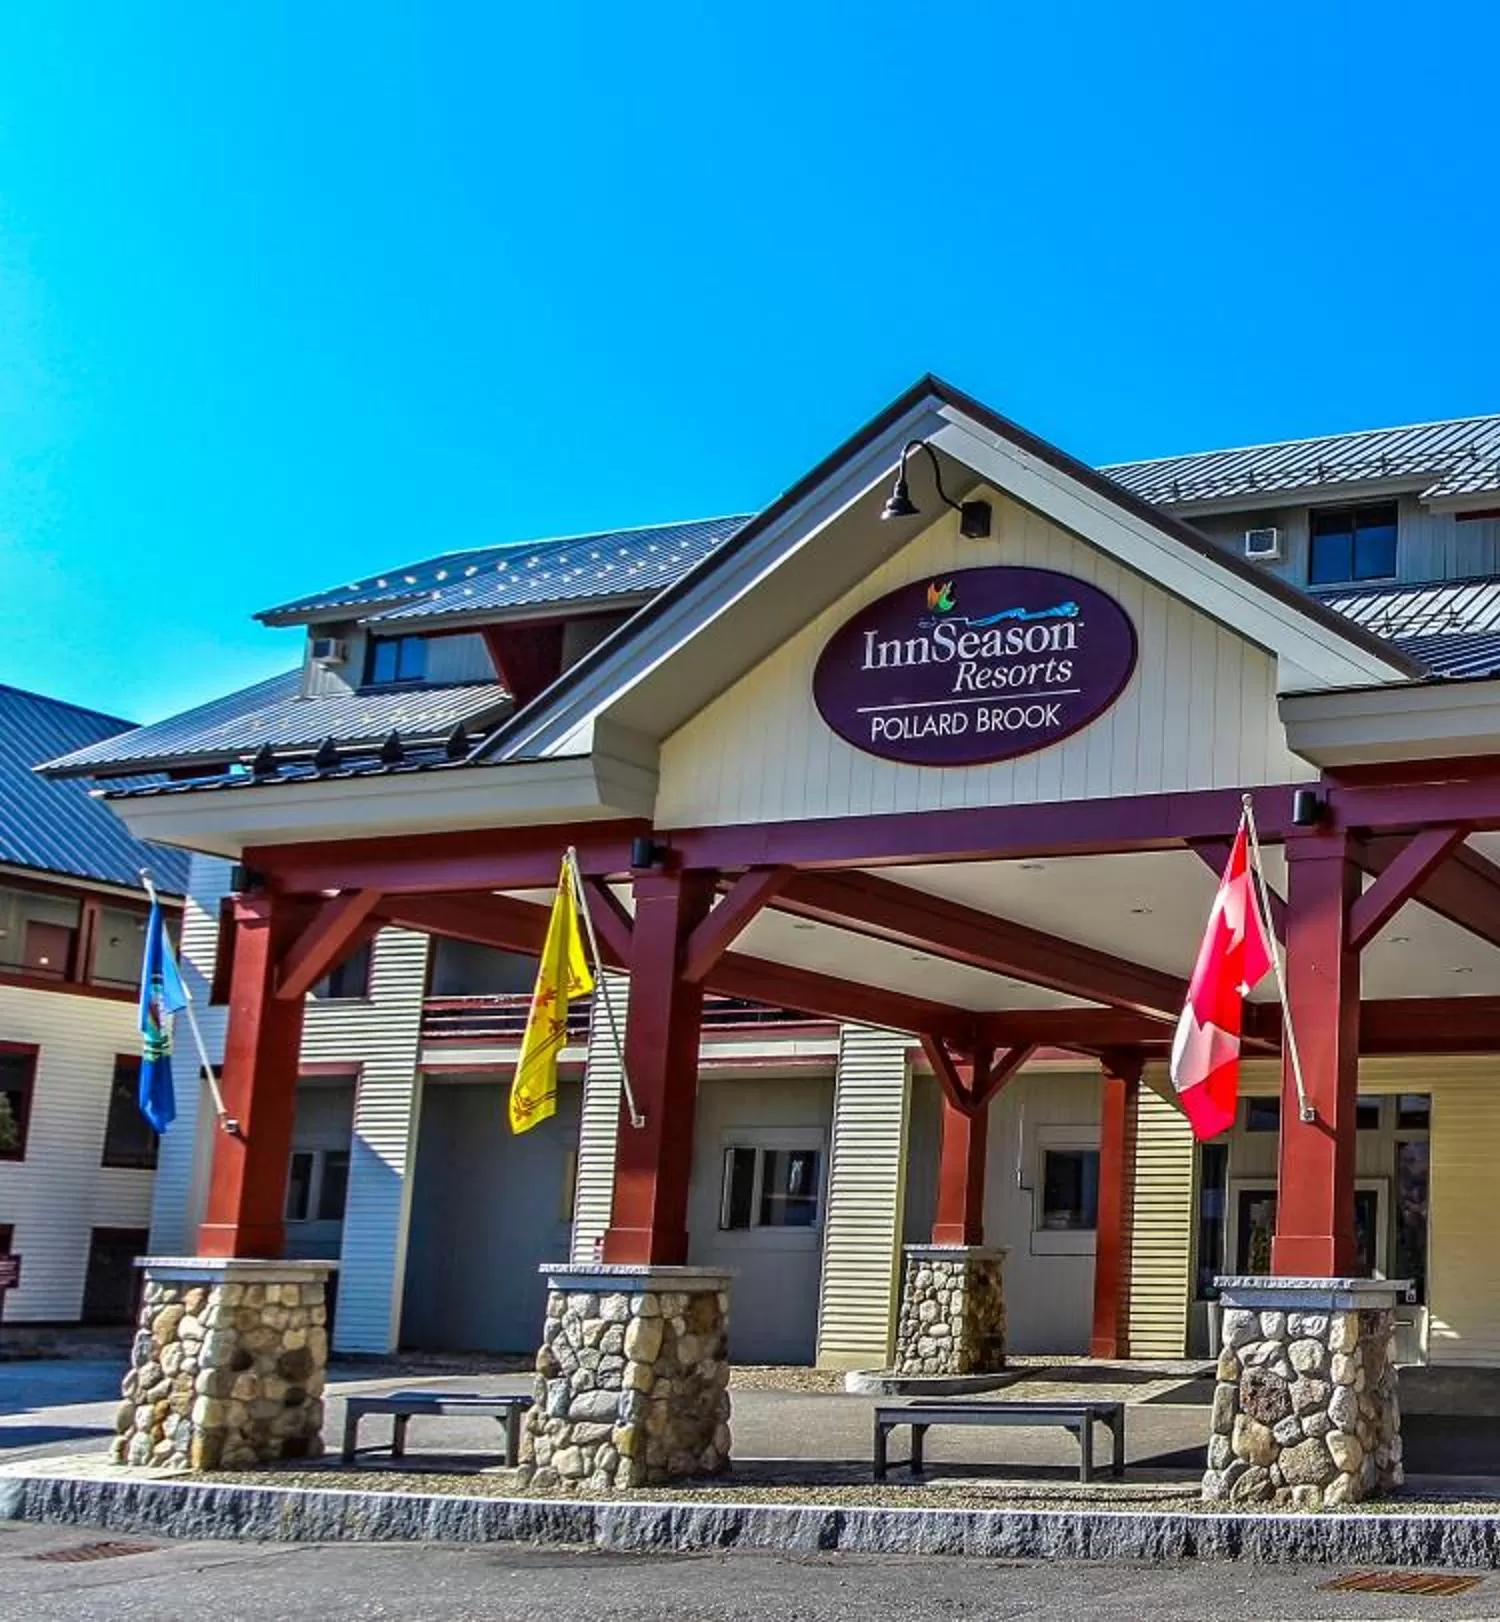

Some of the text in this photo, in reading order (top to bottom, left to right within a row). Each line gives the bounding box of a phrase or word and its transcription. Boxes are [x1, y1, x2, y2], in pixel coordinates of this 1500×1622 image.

[861, 623, 1079, 670] InnSeason
[952, 658, 1073, 692] Resorts
[871, 703, 1061, 742] POLLARD BROOK
